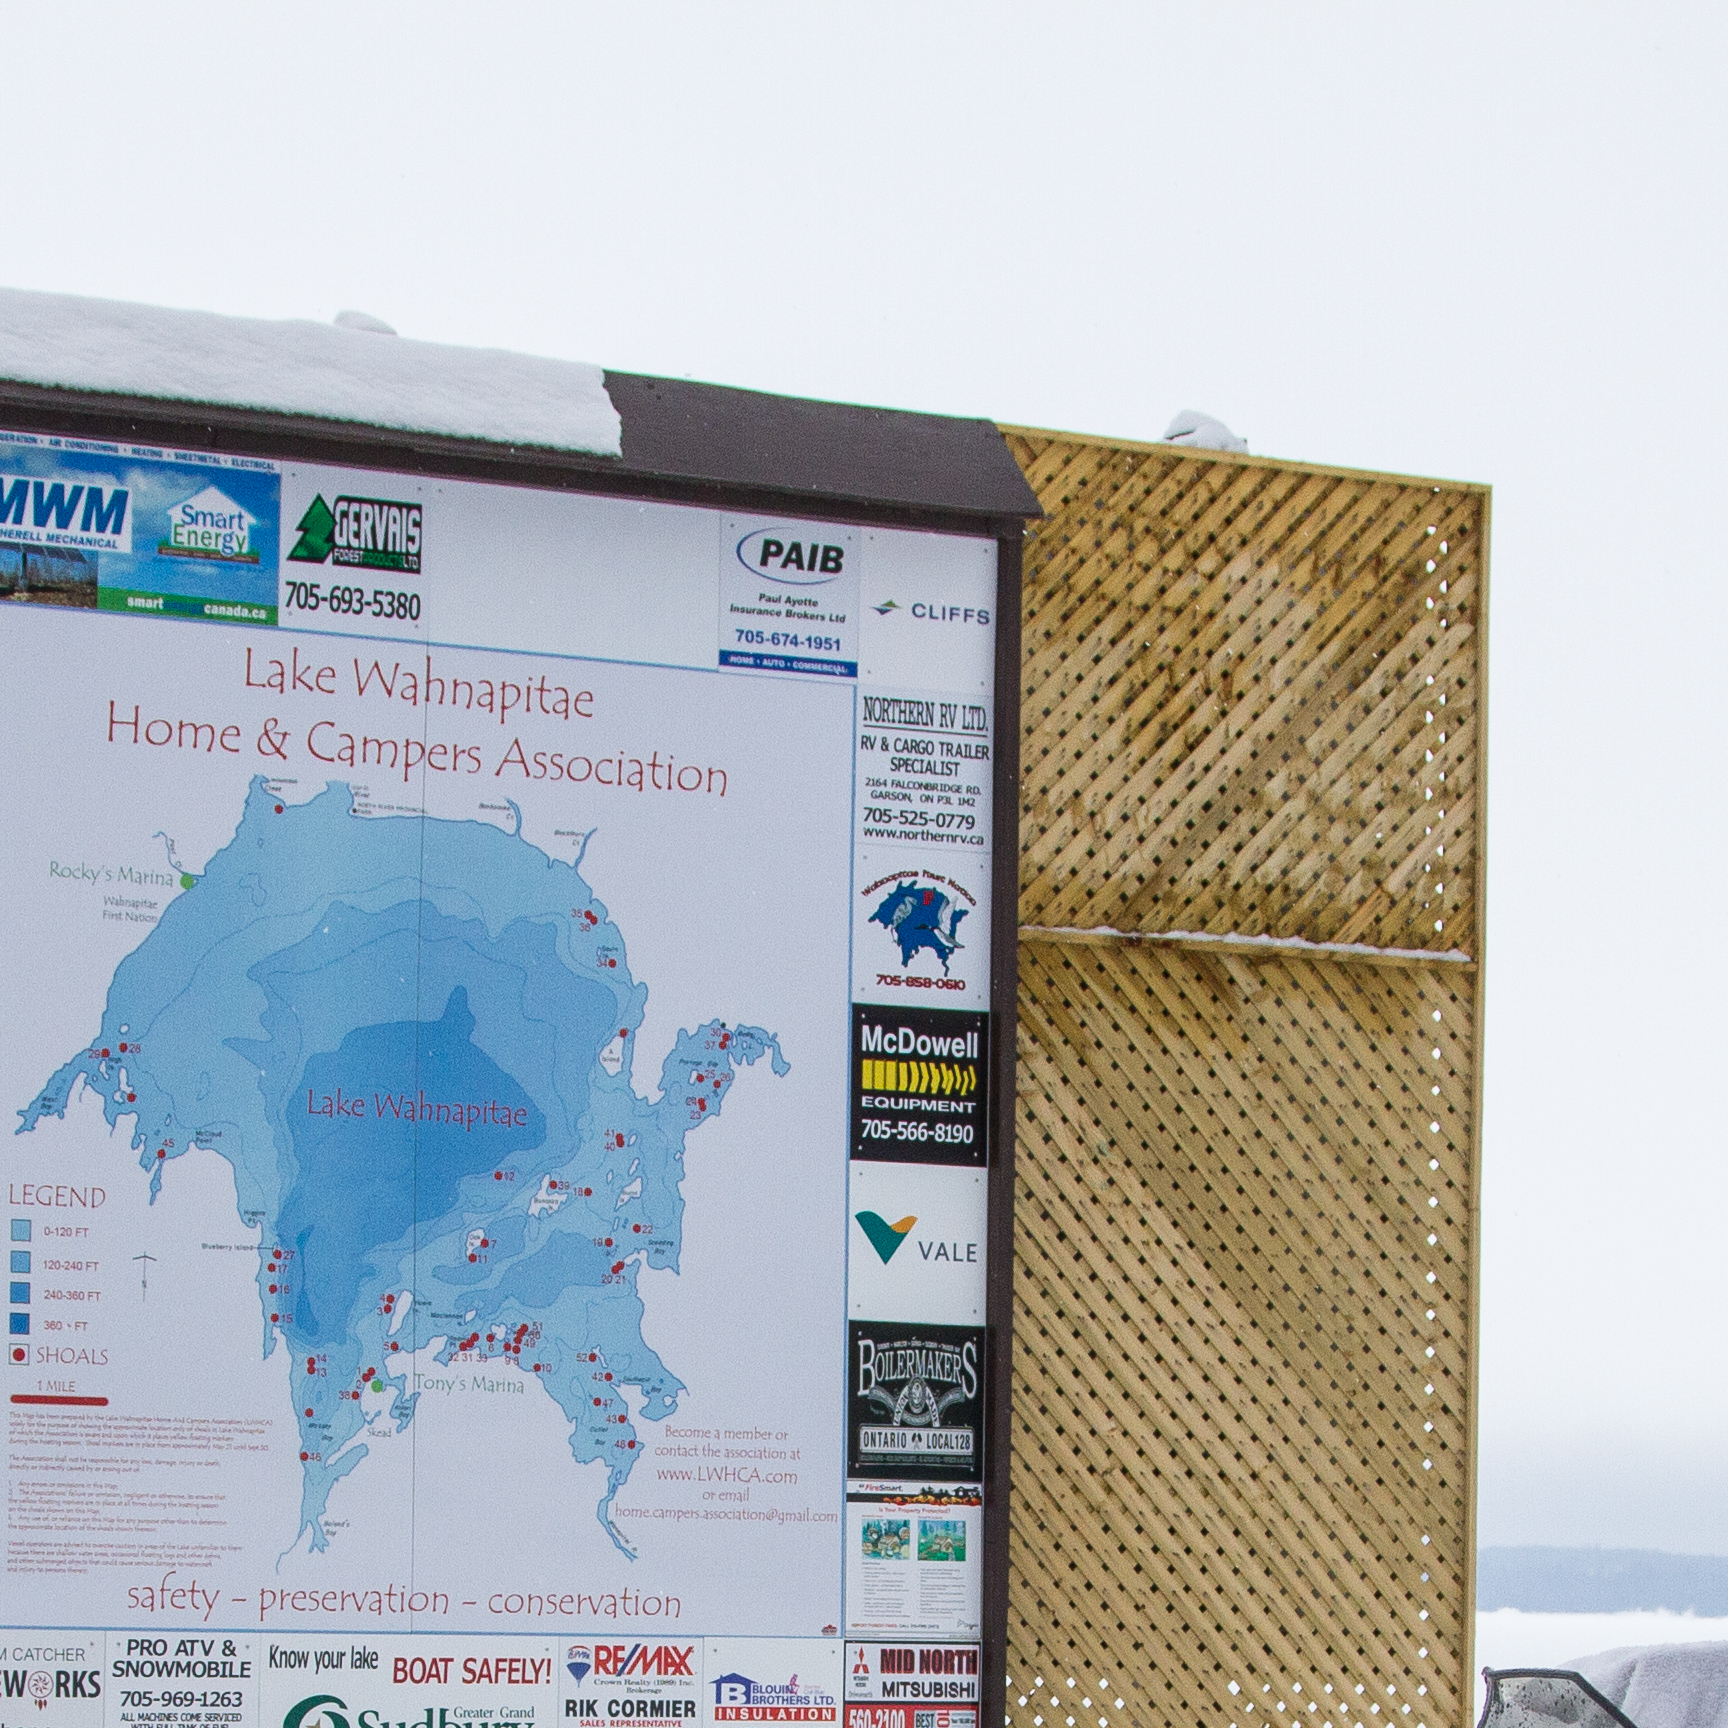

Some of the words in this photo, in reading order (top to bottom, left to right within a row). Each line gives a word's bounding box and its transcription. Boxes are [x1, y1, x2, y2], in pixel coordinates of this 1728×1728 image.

[181, 505, 244, 531] Smart
[334, 501, 420, 554] GERVAIS
[173, 523, 246, 555] Energy
[334, 548, 363, 563] FOREST
[760, 539, 844, 573] PAIB
[286, 581, 420, 620] 705-693-5380
[911, 603, 990, 625] CLIFFS
[736, 628, 840, 651] 705-674-1951
[245, 647, 336, 695] Lake
[354, 656, 594, 724] Wahnapitae
[863, 696, 934, 727] NORTHERN
[940, 704, 957, 728] RV
[962, 705, 988, 731] LTD.
[107, 700, 242, 754] Home
[257, 718, 292, 760] &
[307, 720, 482, 782] Campers
[494, 737, 729, 796] Association
[861, 735, 877, 750] RV
[881, 737, 889, 751] &
[894, 738, 934, 755] CARGO
[939, 741, 989, 760] TRAILER
[890, 757, 960, 776] SPECIALIST
[863, 807, 975, 829] 705-525-0779
[864, 828, 984, 845] www.northernrv.ca
[50, 860, 112, 886] Rocky's
[117, 866, 173, 887] Marina
[861, 1024, 978, 1058] McDowell
[307, 1089, 366, 1118] Lake
[374, 1091, 528, 1132] Wahnapitae
[862, 1096, 976, 1114] EQUIPMENT
[862, 1118, 974, 1144] 705-566-8190
[9, 1183, 106, 1208] LEGEND
[44, 1226, 72, 1237] 0-120
[75, 1228, 89, 1238] FT
[918, 1241, 978, 1263] VALE
[43, 1260, 82, 1271] 120-240
[86, 1261, 99, 1271] FT
[36, 1346, 108, 1365] SHOALS
[46, 1380, 75, 1392] MILE
[414, 1372, 467, 1393] Tony's
[472, 1375, 525, 1395] Marina
[863, 1431, 907, 1448] ONTARIO
[657, 1466, 798, 1484] www.LWHCA.com
[127, 1571, 220, 1622] safety
[259, 1583, 450, 1622] preservation
[488, 1587, 681, 1619] conservation
[13, 1648, 85, 1661] CATCHER
[127, 1639, 167, 1656] PRO
[175, 1640, 215, 1657] ATV
[222, 1640, 236, 1657] &
[269, 1644, 308, 1669] Know
[314, 1647, 346, 1674] your
[350, 1646, 378, 1669] lake
[112, 1661, 251, 1678] SNOWMOBILE
[393, 1658, 454, 1684] BOAT
[462, 1658, 552, 1684] SAFELY!
[594, 1643, 694, 1677] RE/MAX
[880, 1649, 915, 1674] MID
[919, 1649, 978, 1675] NORTH
[120, 1691, 243, 1707] 705-969-1263
[752, 1685, 794, 1694] BLOUIN
[752, 1696, 810, 1705] BROTHERS
[814, 1696, 836, 1705] LTD.
[882, 1681, 975, 1698] MITSUBISHI
[454, 1706, 494, 1718] Greater
[500, 1706, 534, 1718] Grand
[565, 1699, 598, 1717] RIK
[608, 1700, 696, 1718] CORMIER
[719, 1709, 832, 1719] INSULATION
[916, 1714, 934, 1728] BEST
